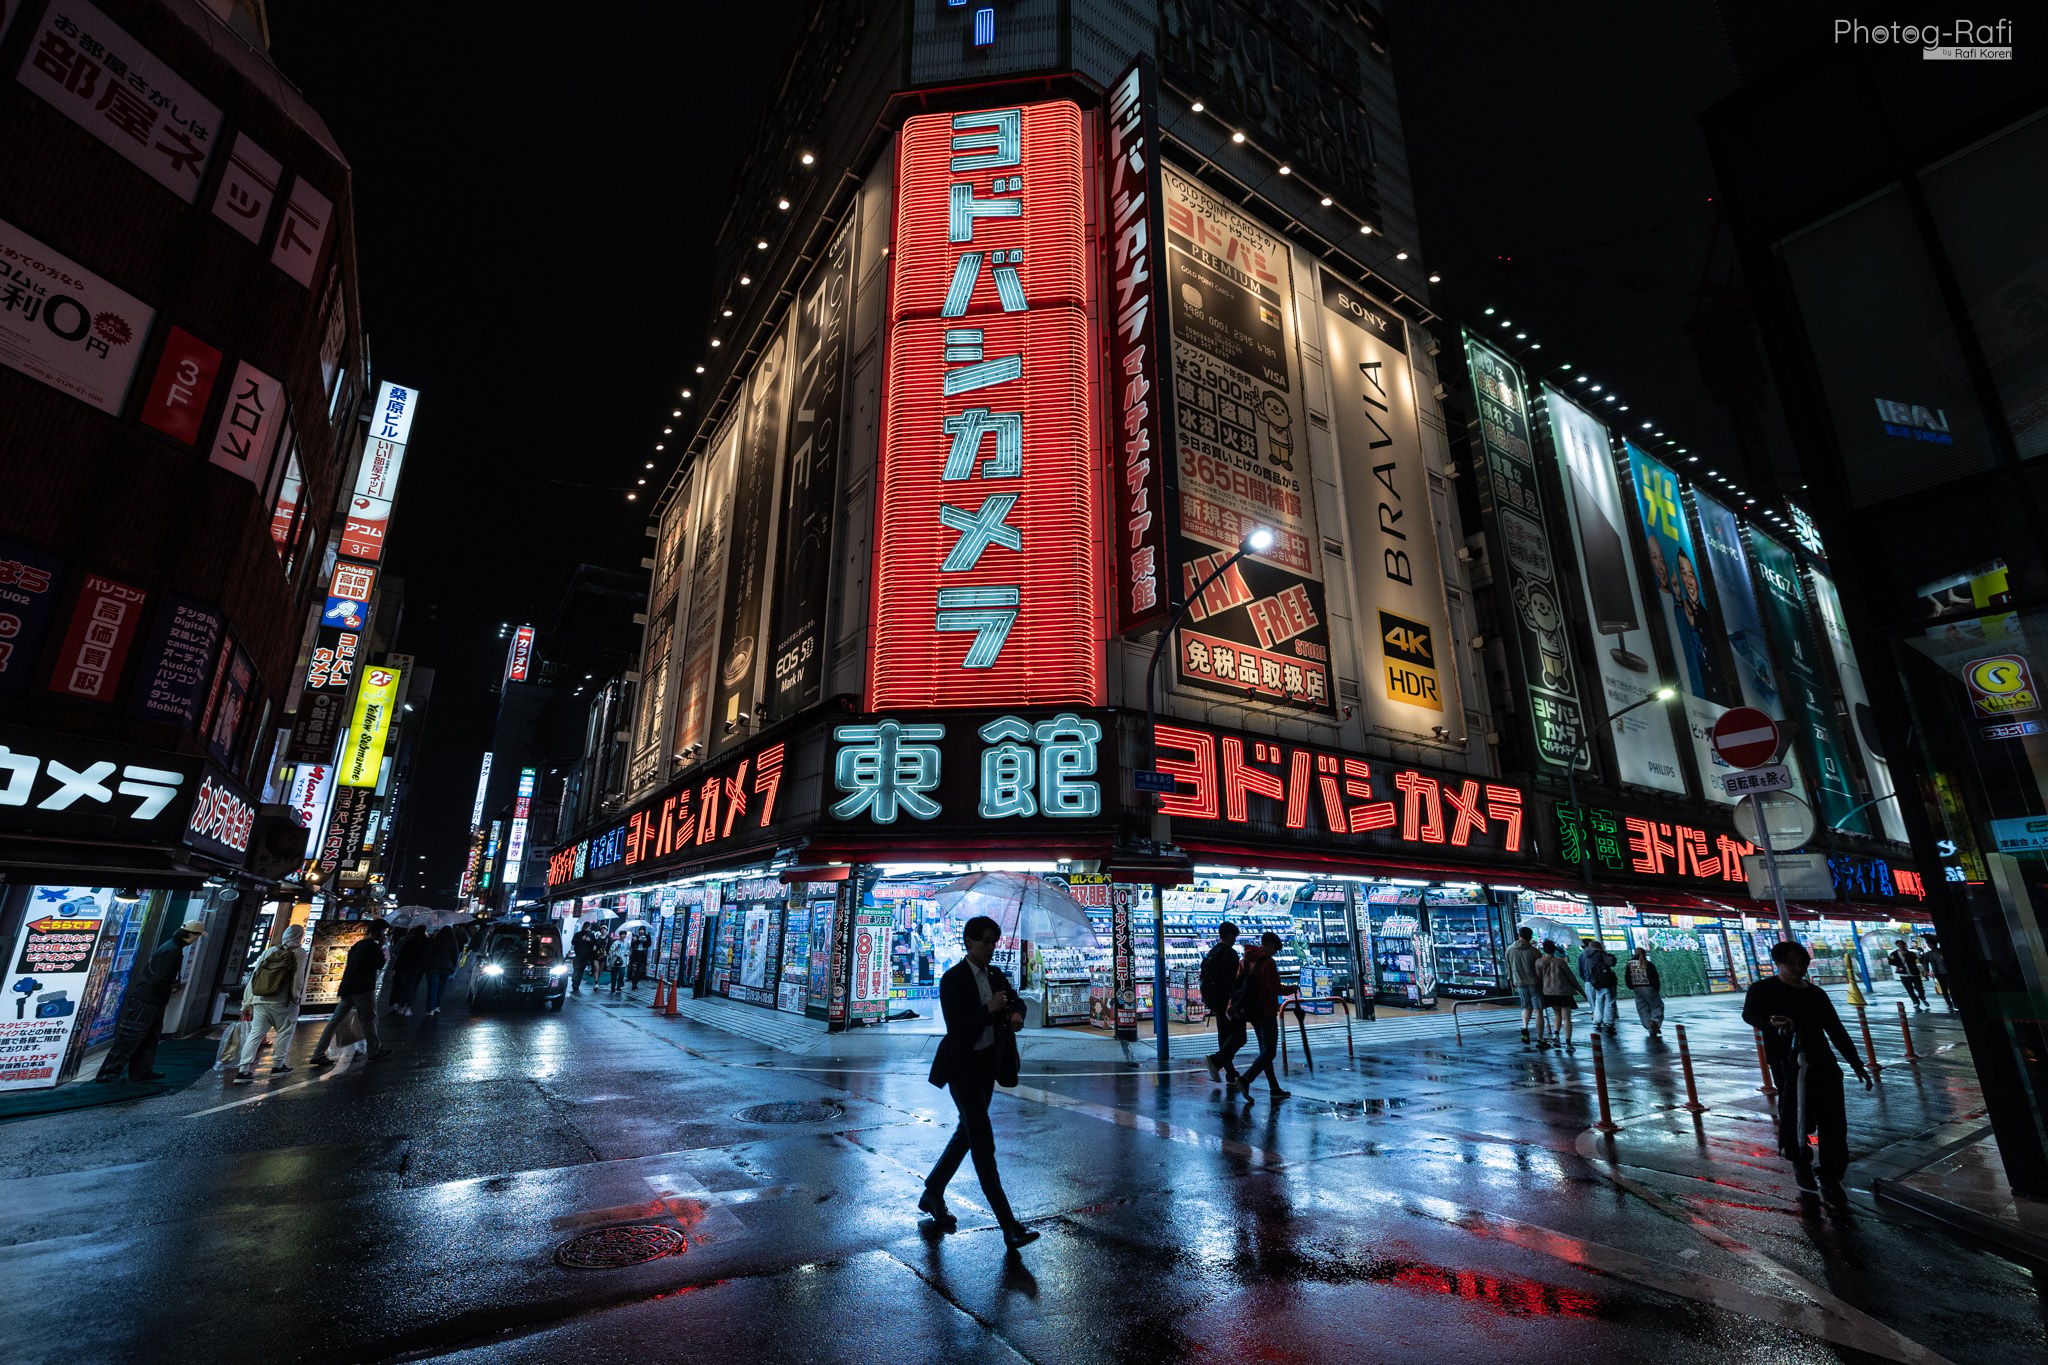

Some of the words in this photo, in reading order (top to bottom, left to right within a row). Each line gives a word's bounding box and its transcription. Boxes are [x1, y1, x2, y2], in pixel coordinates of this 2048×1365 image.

[54, 14, 207, 141] お部屋さがしは
[1110, 67, 1148, 344] ヨドバシカメラ
[1172, 178, 1198, 202] GOLD
[1200, 193, 1228, 217] POINT
[1230, 210, 1254, 235] CARD
[1180, 194, 1264, 253] アップグレードサービス
[1167, 197, 1277, 284] ヨドバシ
[1191, 245, 1262, 294] PREMIUM
[1338, 293, 1387, 332] SONY
[936, 108, 1030, 669] ヨドバシカメラ
[1262, 366, 1287, 388] VISA
[231, 378, 264, 435] 入口
[381, 386, 407, 438] 桑原ビル
[1178, 432, 1300, 492] 今日お買い上げの商品から
[1222, 426, 1257, 459] 火災
[367, 440, 389, 495] いい部屋ネット
[1122, 344, 1157, 613] マルチメディア東館
[1179, 447, 1303, 519] 365日間補償
[1359, 361, 1413, 586] BRAVIA
[1641, 464, 1679, 542] 光
[346, 522, 382, 537] アコム
[351, 545, 370, 555] 3F
[1184, 502, 1306, 554] 新規会員集中
[86, 578, 147, 604] パソコン!
[338, 585, 364, 598] 買取
[1183, 551, 1254, 623] TAX
[1758, 562, 1801, 600] REGZA
[345, 617, 359, 626] 2F
[1246, 583, 1319, 650] FREE
[68, 596, 127, 696] 高価買取
[329, 633, 358, 686] ヨドバシ
[513, 639, 529, 673] カラオケ
[776, 647, 798, 678] EOS
[1295, 639, 1326, 661] STORE
[1385, 627, 1432, 658] 4K
[309, 648, 333, 688] カメラ
[369, 670, 394, 686] 2F
[781, 675, 796, 693] Mark
[1186, 639, 1325, 698] 免税品取扱店
[1389, 666, 1438, 701] HDR
[362, 704, 379, 733] Yellow
[1534, 698, 1580, 726] ヨドバシ
[1543, 720, 1576, 744] カメラ
[352, 733, 373, 781] Submarine
[829, 714, 1102, 824] 東館
[1648, 761, 1676, 778] PHILIPS
[626, 743, 784, 865] ヨドバシカメラ
[1154, 724, 1522, 852] ヨドバシカメラ
[1727, 772, 1787, 792] 自転車を除く
[190, 776, 255, 853] カメラ総合館
[321, 788, 354, 873] ヨドバシカメラ
[29, 934, 95, 942] ウェアラブルカメラ
[40, 921, 95, 930] こちらです
[27, 943, 91, 953] 360度カメラ
[27, 953, 86, 962] ビデオカメラ
[33, 963, 75, 971] ドローン
